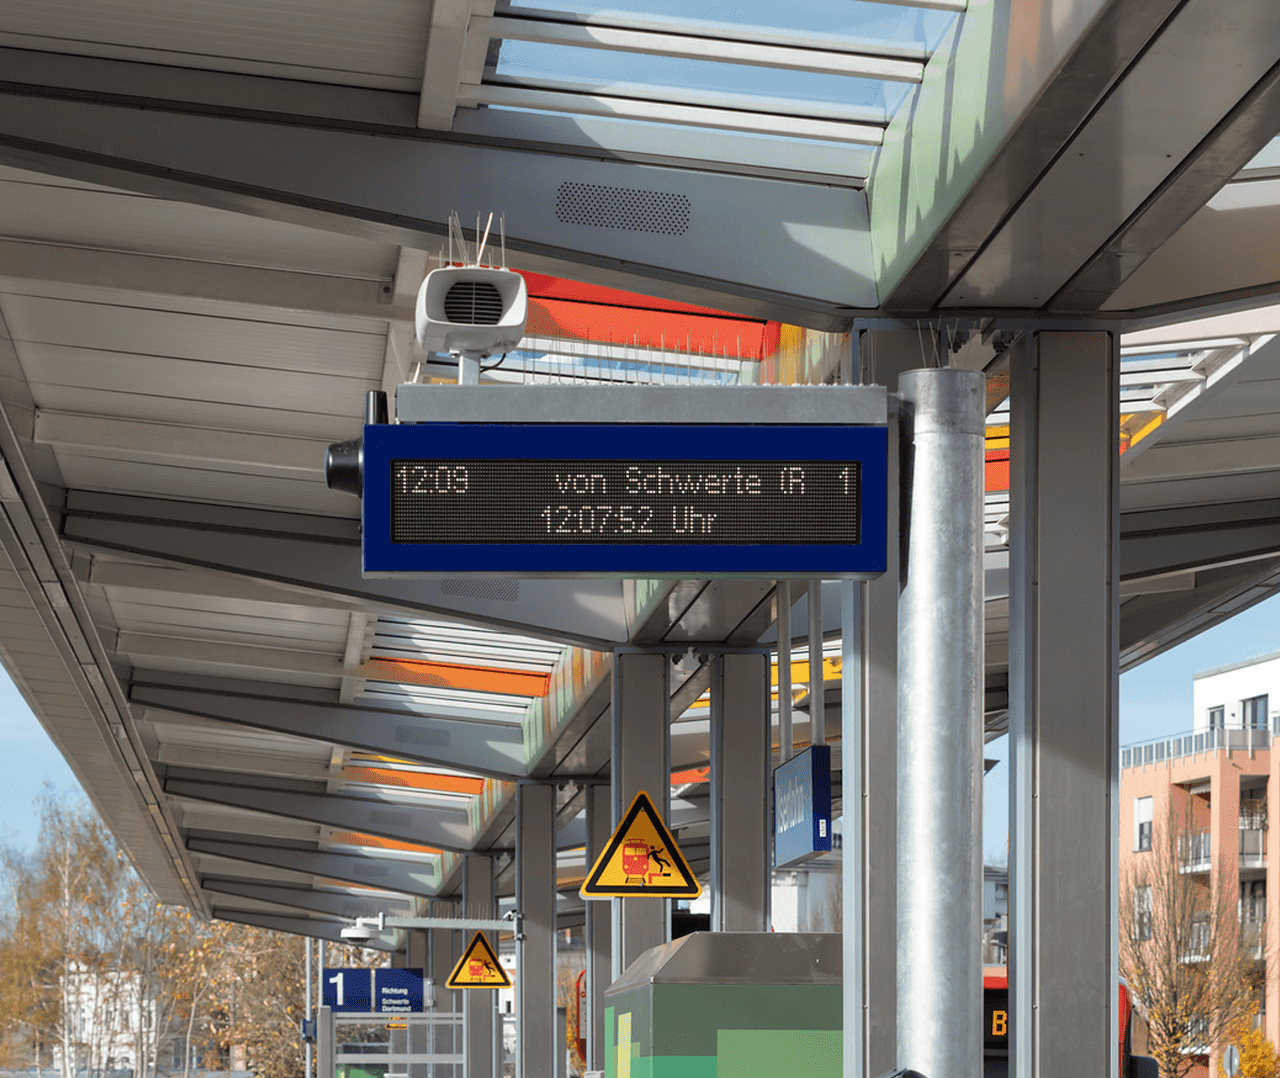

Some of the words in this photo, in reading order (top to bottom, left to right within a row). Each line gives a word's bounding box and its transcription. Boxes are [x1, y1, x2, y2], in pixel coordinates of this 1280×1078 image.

[396, 464, 469, 494] 12:09
[554, 473, 607, 494] von
[625, 466, 762, 494] Schwerte
[780, 466, 804, 495] (R
[837, 466, 849, 495] 1
[540, 504, 653, 533] 12:07:52
[672, 505, 718, 533] Uhr
[329, 972, 344, 1005] 1
[381, 987, 409, 995] Richtung
[992, 1010, 1008, 1036] B
